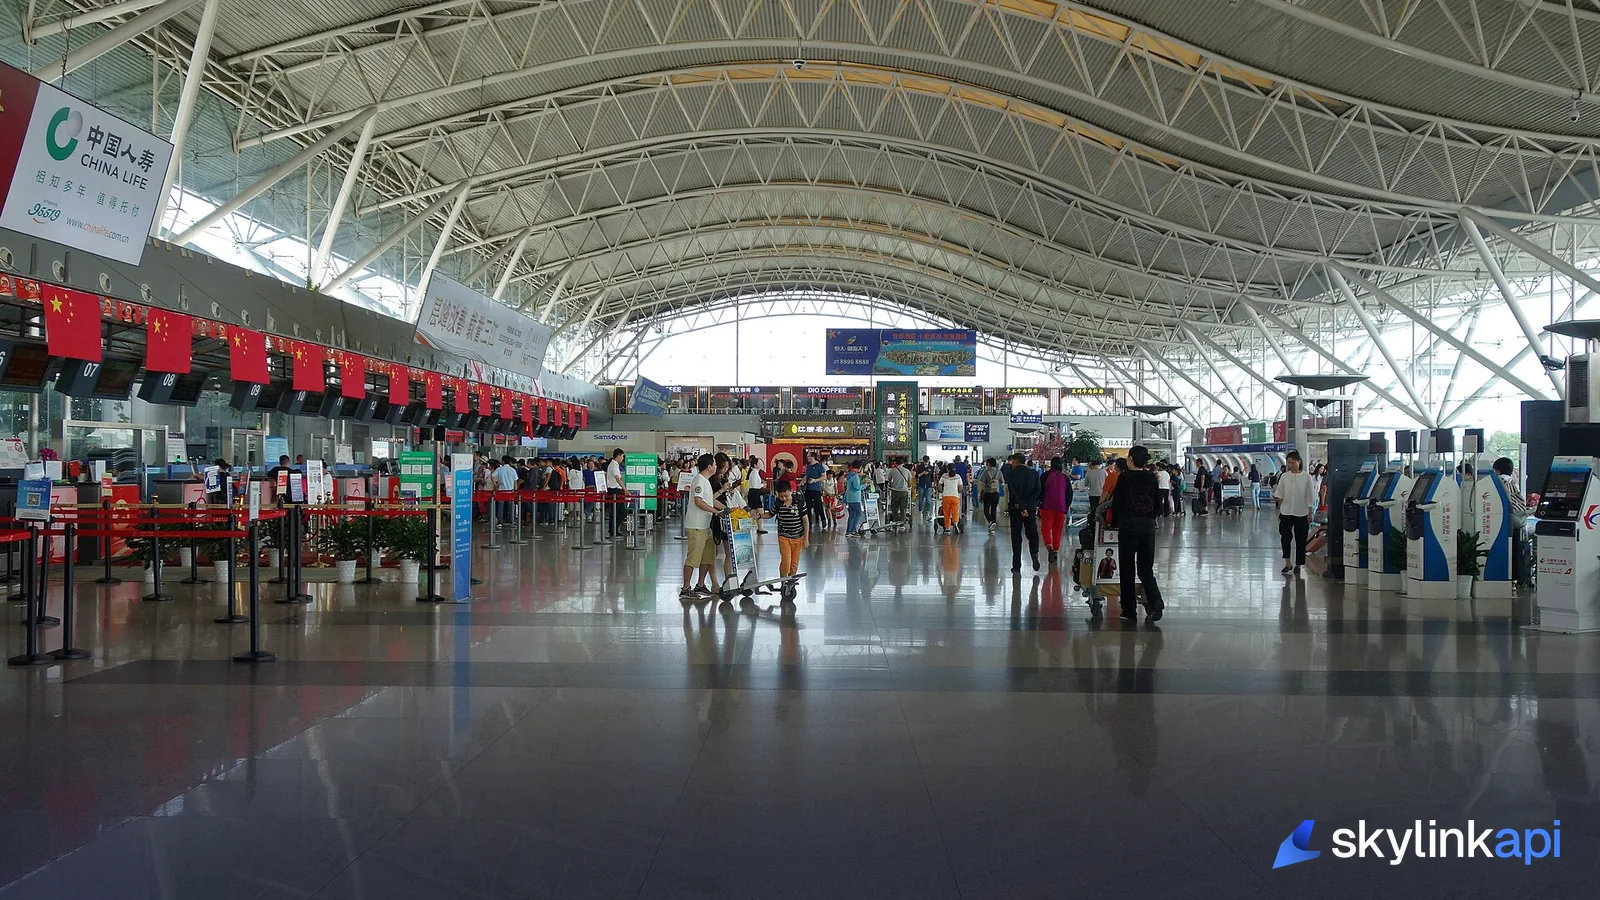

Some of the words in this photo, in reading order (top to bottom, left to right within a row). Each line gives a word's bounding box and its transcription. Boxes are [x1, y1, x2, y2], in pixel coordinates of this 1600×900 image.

[86, 125, 156, 173] 中国人寿
[80, 154, 119, 180] CHINA
[122, 170, 149, 191] LIFE
[35, 168, 87, 198] 相知多年
[96, 191, 141, 218] 值得托付
[27, 202, 61, 222] 95519
[66, 216, 130, 244] www.chinalife.com.cn
[83, 362, 99, 378] 07
[162, 373, 176, 387] 08
[250, 384, 260, 396] 09
[297, 390, 306, 401] 10
[336, 397, 344, 406] 11
[369, 401, 377, 410] 12
[398, 406, 405, 415] 13
[887, 393, 896, 443] 迪欧咖啡
[898, 392, 907, 443] 兰州牛肉拉面
